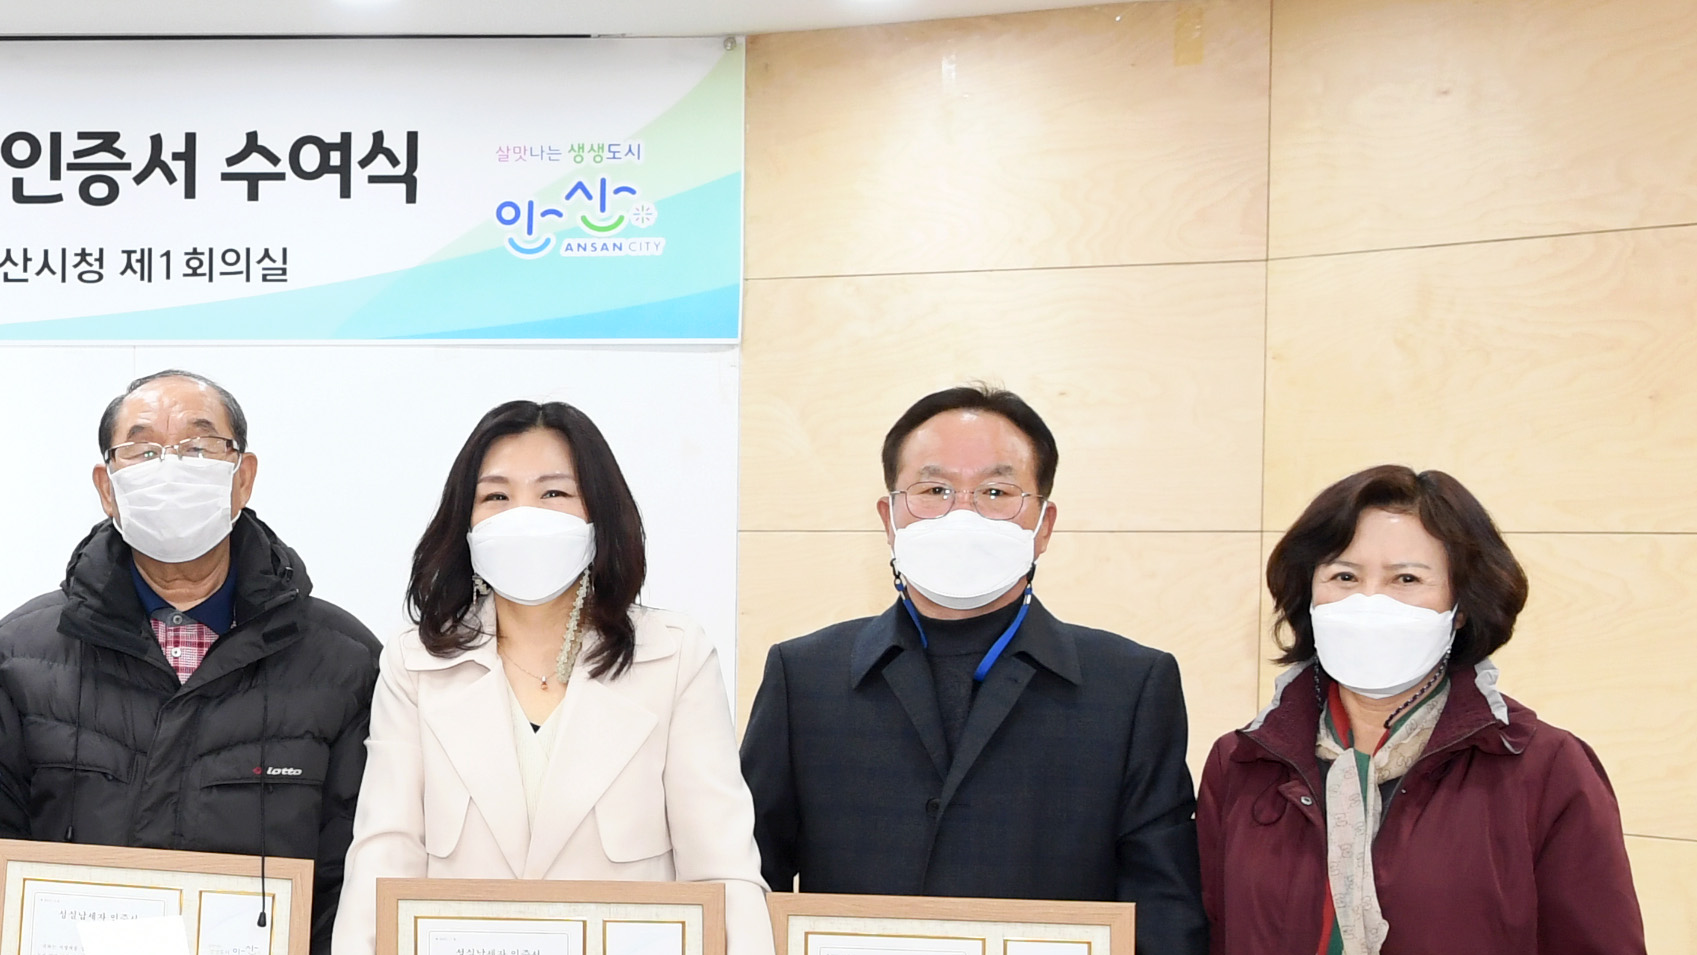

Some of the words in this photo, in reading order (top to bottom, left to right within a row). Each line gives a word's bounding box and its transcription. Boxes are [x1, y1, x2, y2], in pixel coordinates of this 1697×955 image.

[1, 131, 196, 206] 인증서
[221, 130, 418, 204] 수여식
[495, 145, 562, 163] 살맛나는
[568, 143, 641, 164] 생생도시
[496, 177, 637, 255] 안산
[564, 242, 623, 252] ANSAN
[628, 241, 661, 251] CITY
[119, 247, 287, 284] 제1회의실
